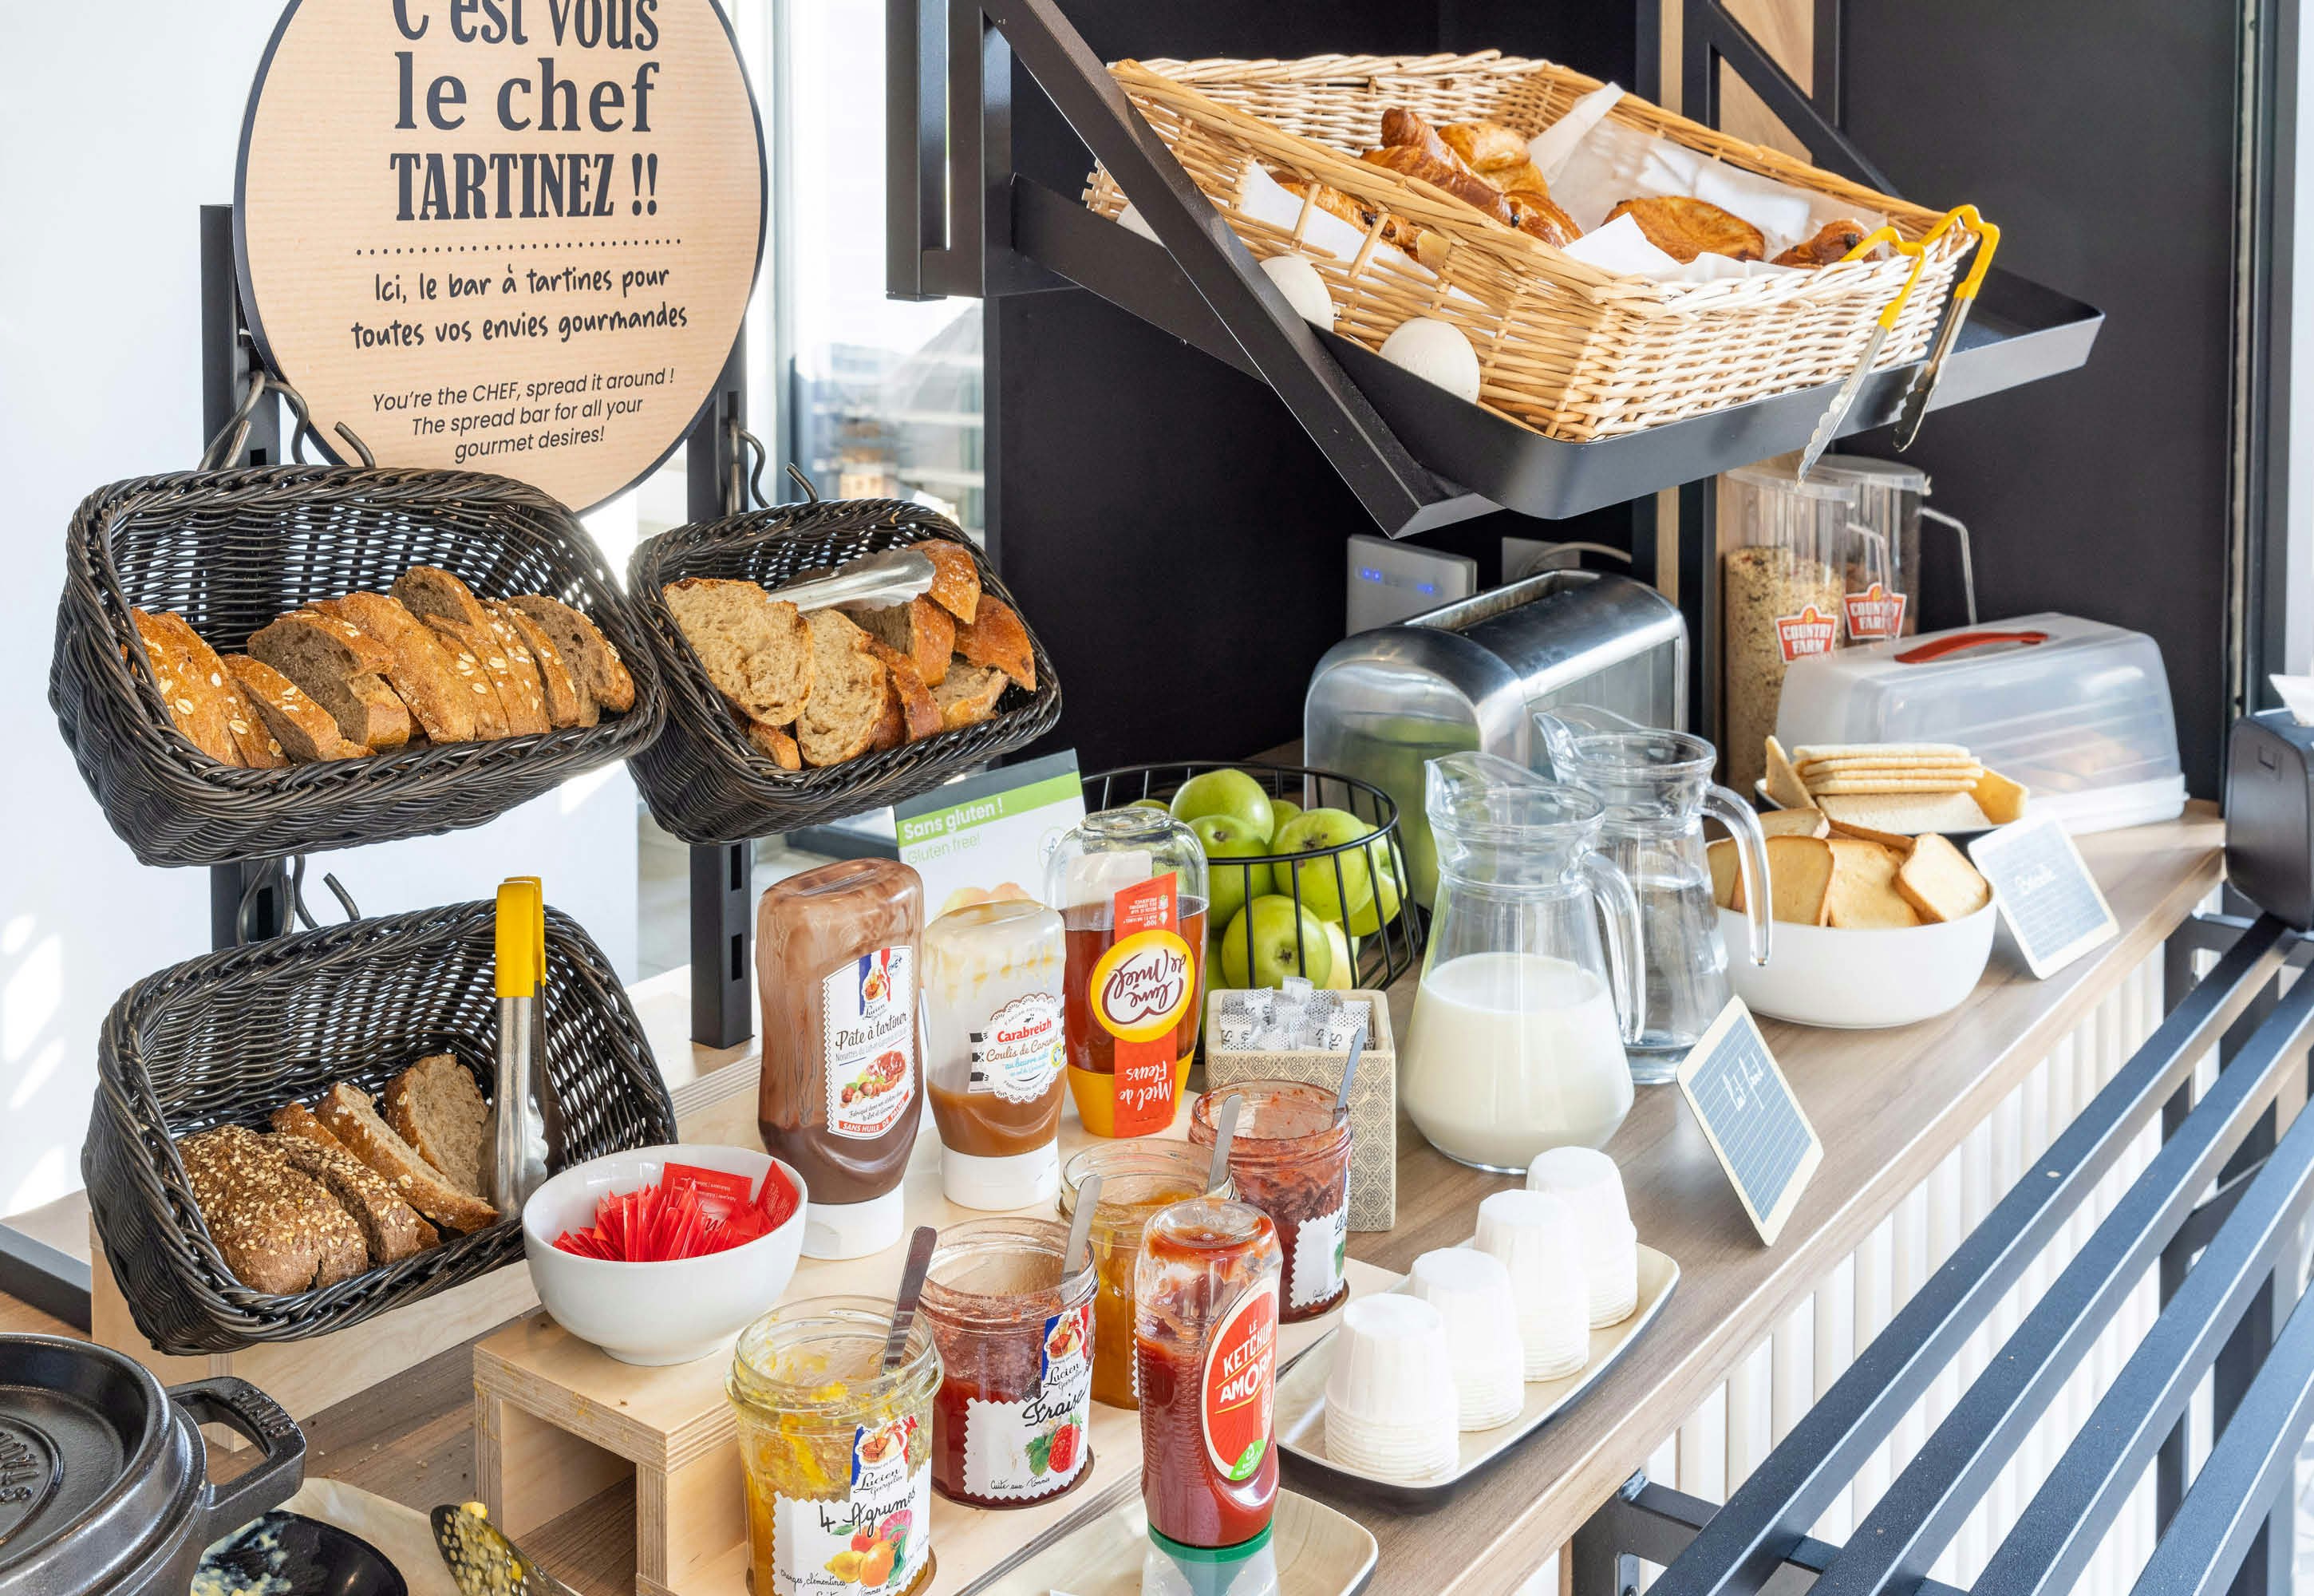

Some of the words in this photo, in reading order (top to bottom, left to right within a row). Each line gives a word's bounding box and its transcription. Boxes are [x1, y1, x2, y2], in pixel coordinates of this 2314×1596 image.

[393, 0, 528, 45] Cest
[394, 52, 467, 130] le
[496, 57, 660, 132] chef
[389, 152, 615, 221] TARTINEZ
[631, 152, 658, 216] !!
[375, 273, 407, 303] Ici,
[419, 272, 437, 301] le
[448, 273, 492, 299] bar
[501, 263, 516, 294] à
[526, 266, 612, 294] tartines
[622, 267, 669, 298] pour
[351, 319, 424, 350] toutes
[435, 319, 472, 342] vos
[483, 311, 548, 341] envies
[559, 302, 687, 342] gourmandes
[437, 386, 467, 406] the
[472, 381, 522, 403] CHEF,
[526, 376, 587, 399] spread
[592, 373, 602, 392] it
[606, 368, 665, 390] around
[669, 368, 675, 384] !
[412, 415, 445, 437] The
[450, 407, 513, 436] spread
[519, 404, 551, 424] bar
[555, 401, 578, 421] for
[582, 399, 602, 418] all
[606, 397, 643, 421] your
[454, 438, 534, 464] gourmet
[538, 425, 605, 449] desires!
[1782, 623, 1833, 640] COUNTRY
[1792, 639, 1826, 655] FARM
[902, 817, 942, 839] Sans
[946, 801, 995, 832] gluten
[997, 798, 1003, 814] !
[906, 844, 950, 866] Gluten
[835, 1029, 865, 1051] Pâte
[867, 1026, 875, 1041] à
[875, 1011, 907, 1037] tartiner
[997, 1017, 1052, 1043] Carabreizh
[986, 1045, 1017, 1062] Coulis
[1020, 1043, 1029, 1054] de
[1125, 1060, 1167, 1080] Fleurs
[1119, 1087, 1131, 1106] de
[1135, 1079, 1173, 1111] Miel
[842, 1122, 861, 1132] SANS
[862, 1124, 880, 1132] HUILE
[882, 1118, 889, 1128] DE
[1249, 1319, 1258, 1334] LE
[1223, 1319, 1273, 1377] KETCHUP
[1043, 1363, 1079, 1388] Lucien
[1219, 1347, 1273, 1403] AMORA
[1022, 1383, 1088, 1427] Fraise
[854, 1469, 900, 1493] Lucien
[819, 1505, 836, 1532] 4
[843, 1486, 916, 1538] Agrumes
